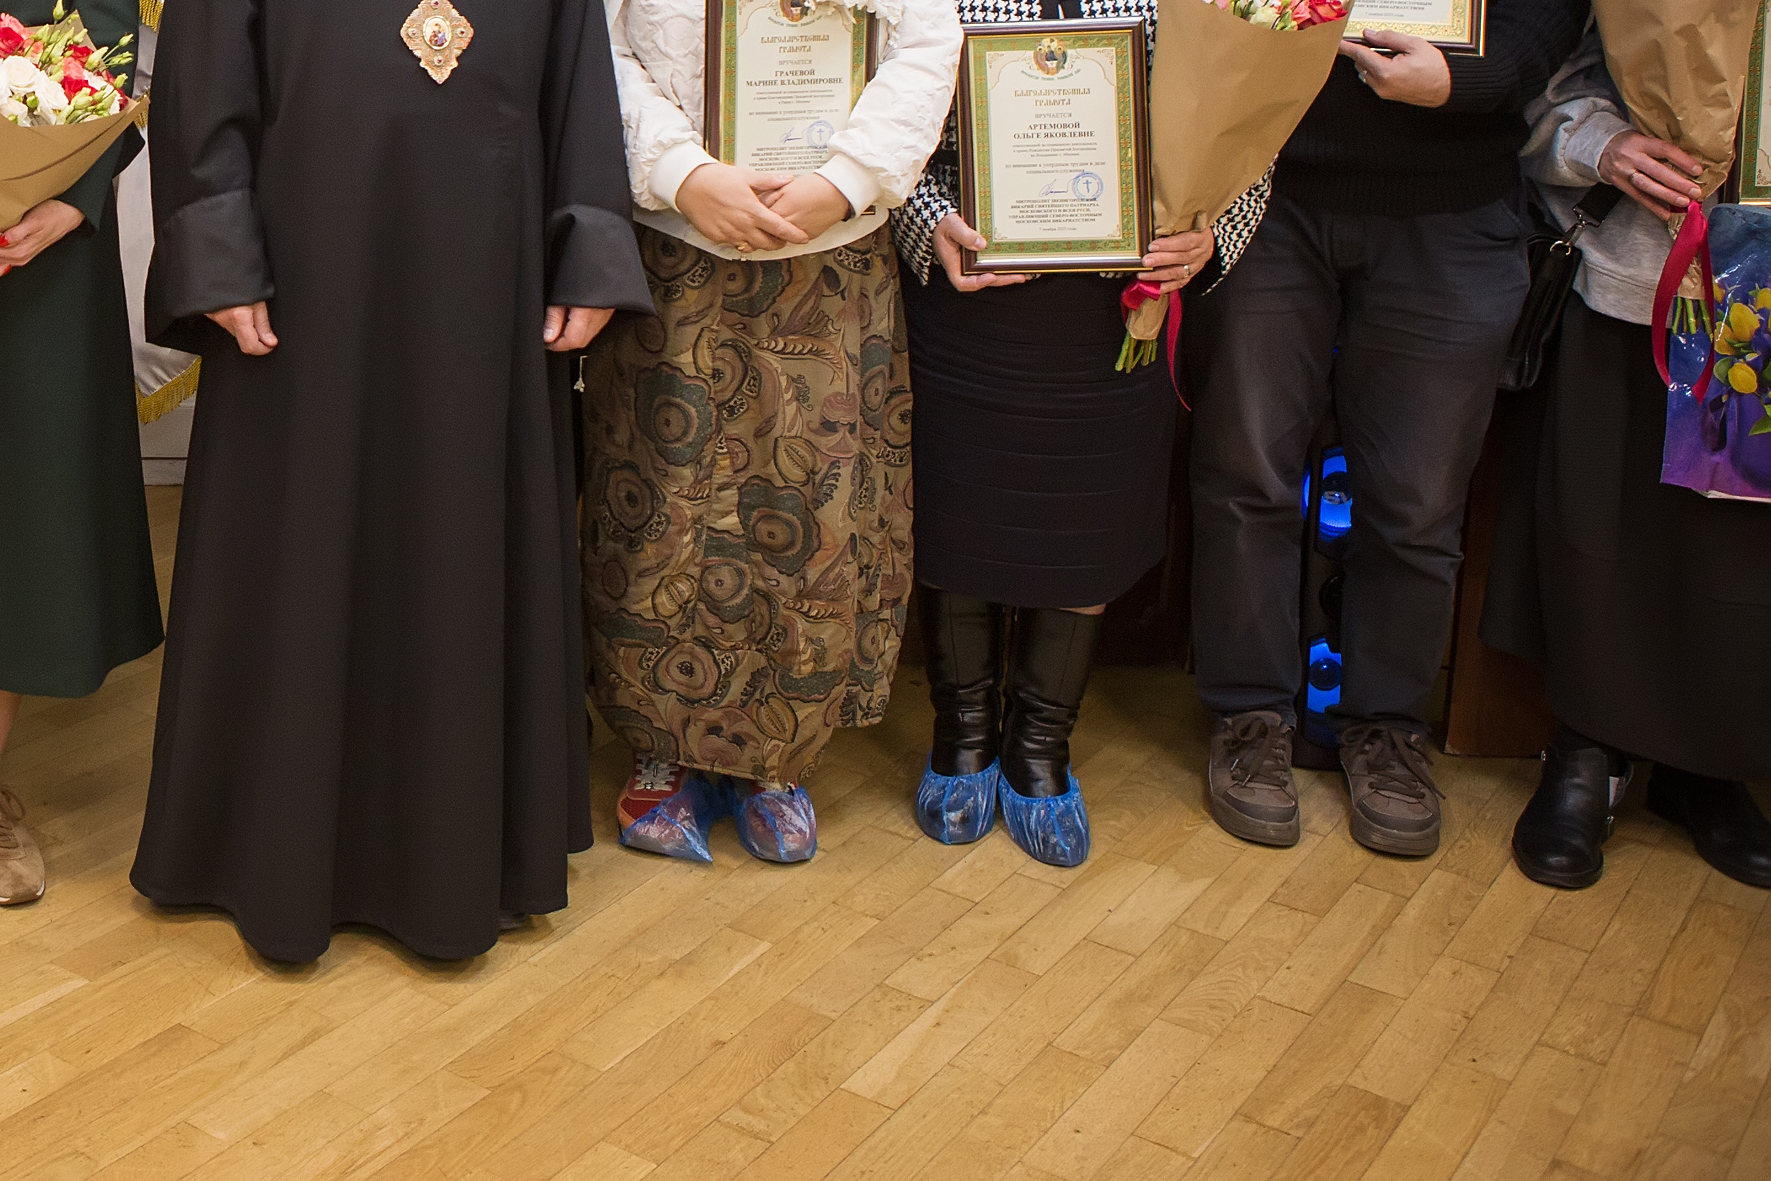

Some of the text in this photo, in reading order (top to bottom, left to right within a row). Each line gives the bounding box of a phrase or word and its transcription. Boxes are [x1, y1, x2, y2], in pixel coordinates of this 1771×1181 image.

[775, 69, 815, 77] ГРАЧЕВОЙ
[780, 77, 843, 85] ВЛАДИМИРОВНЕ
[1027, 121, 1080, 130] АРТЕМОВОЙ
